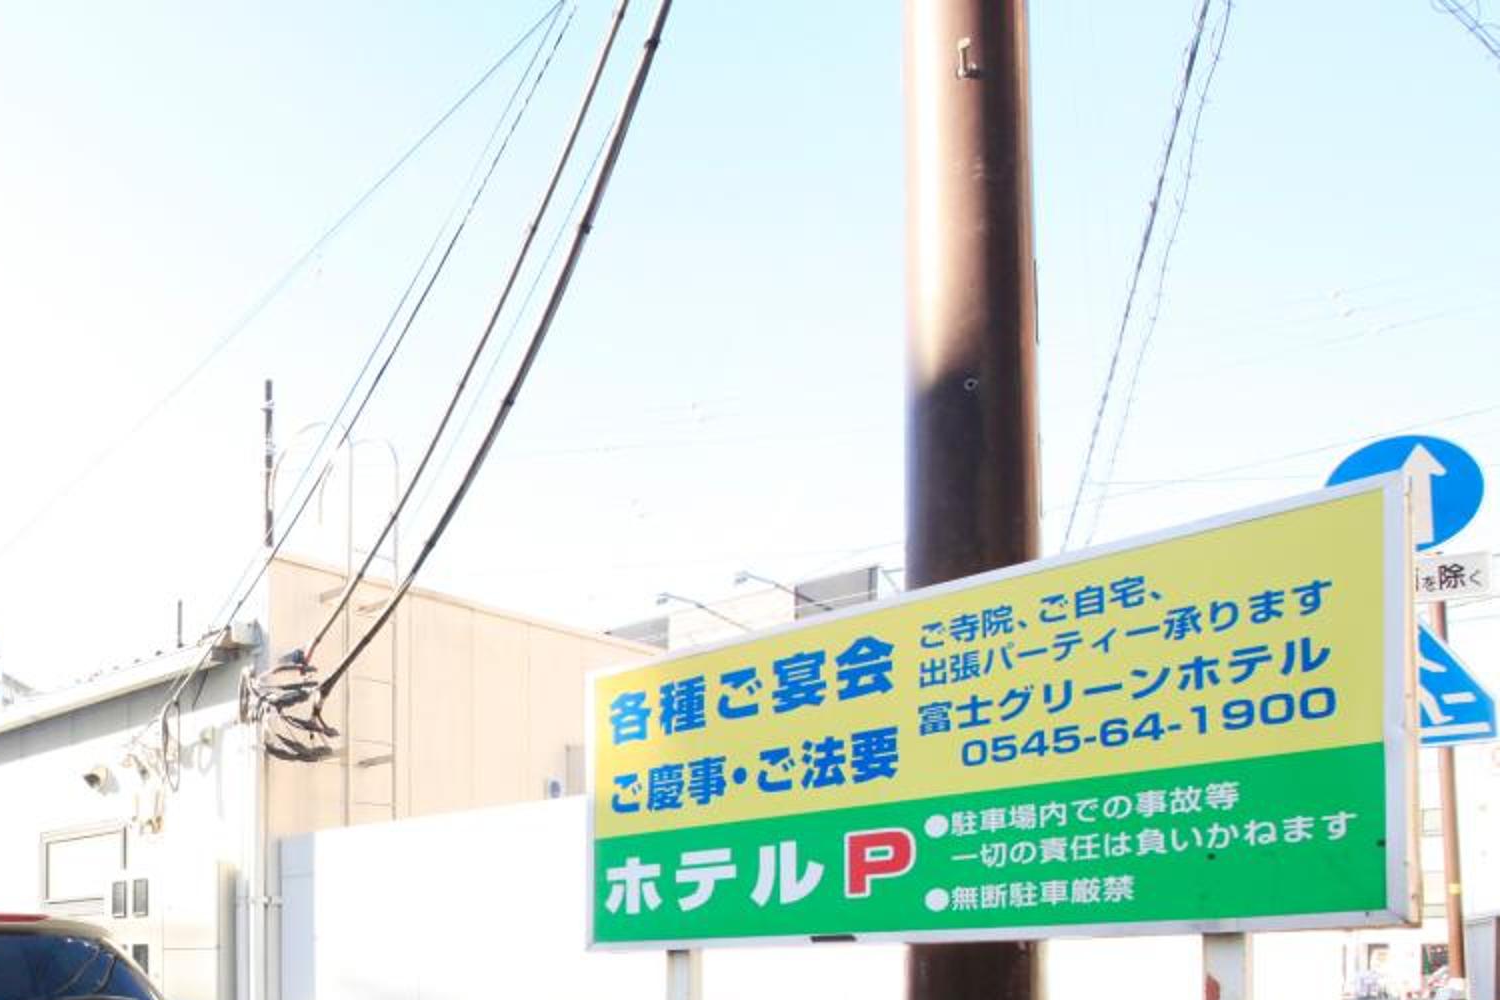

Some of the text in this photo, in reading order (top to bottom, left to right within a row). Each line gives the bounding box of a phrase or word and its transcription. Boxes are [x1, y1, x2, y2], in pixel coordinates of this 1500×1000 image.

[920, 575, 1161, 648] ご寺院、ご自宅、
[1415, 563, 1483, 592] を除く
[919, 580, 1332, 688] 出張パーティー承ります
[610, 636, 895, 744] 各種ご宴会
[918, 637, 1331, 736] 富士グリーンホテル
[961, 686, 1336, 766] 0545-64-1900
[611, 726, 899, 813] ご慶事・ご法要
[604, 827, 917, 914] ホテル P
[951, 811, 1358, 867] 一切の責任は負いかねます
